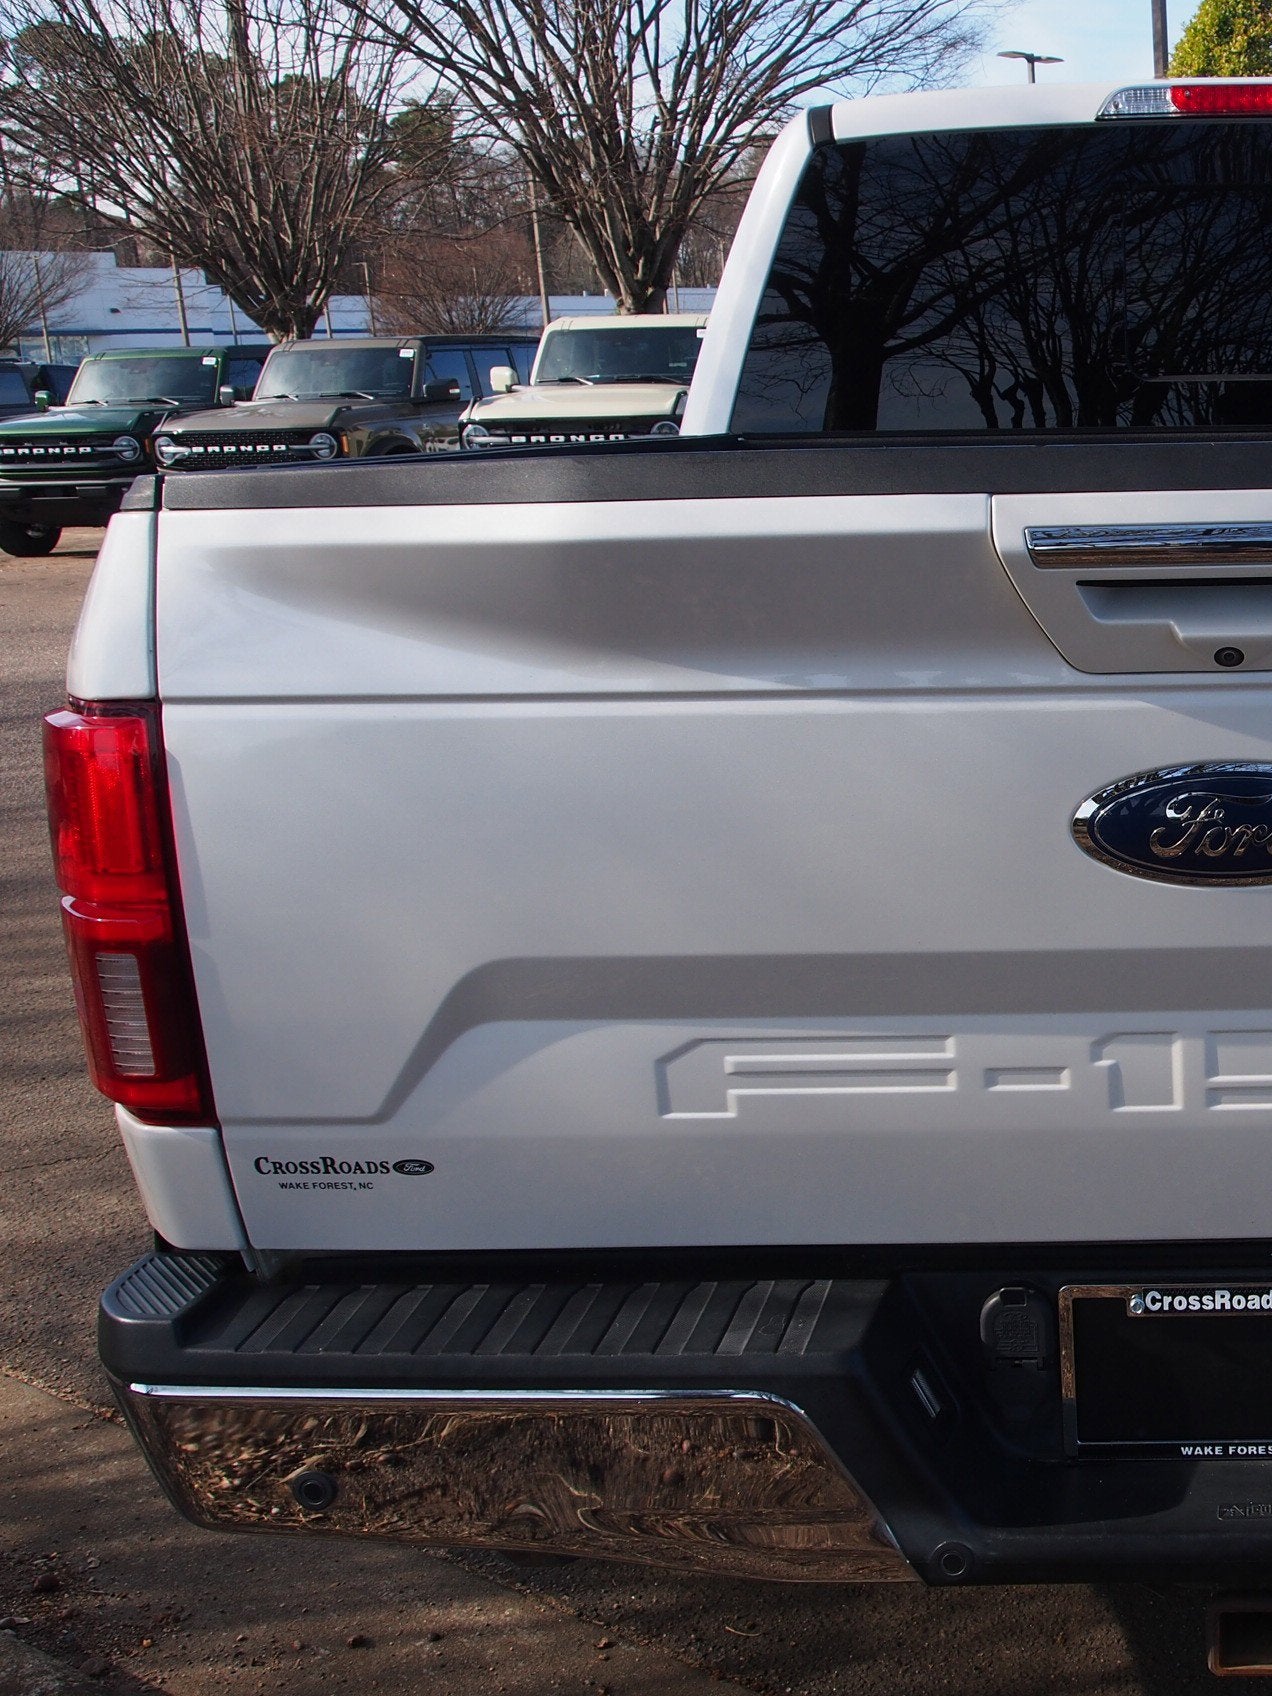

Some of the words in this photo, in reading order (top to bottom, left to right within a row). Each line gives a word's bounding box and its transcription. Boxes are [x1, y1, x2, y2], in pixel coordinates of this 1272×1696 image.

[511, 434, 626, 444] BRONCO
[3, 447, 92, 456] BRONCO
[192, 445, 286, 454] BRONCO
[279, 1182, 309, 1190] WAKE
[313, 1182, 357, 1191] FOREST,
[359, 1182, 374, 1190] NC
[1181, 1446, 1223, 1456] WAKE
